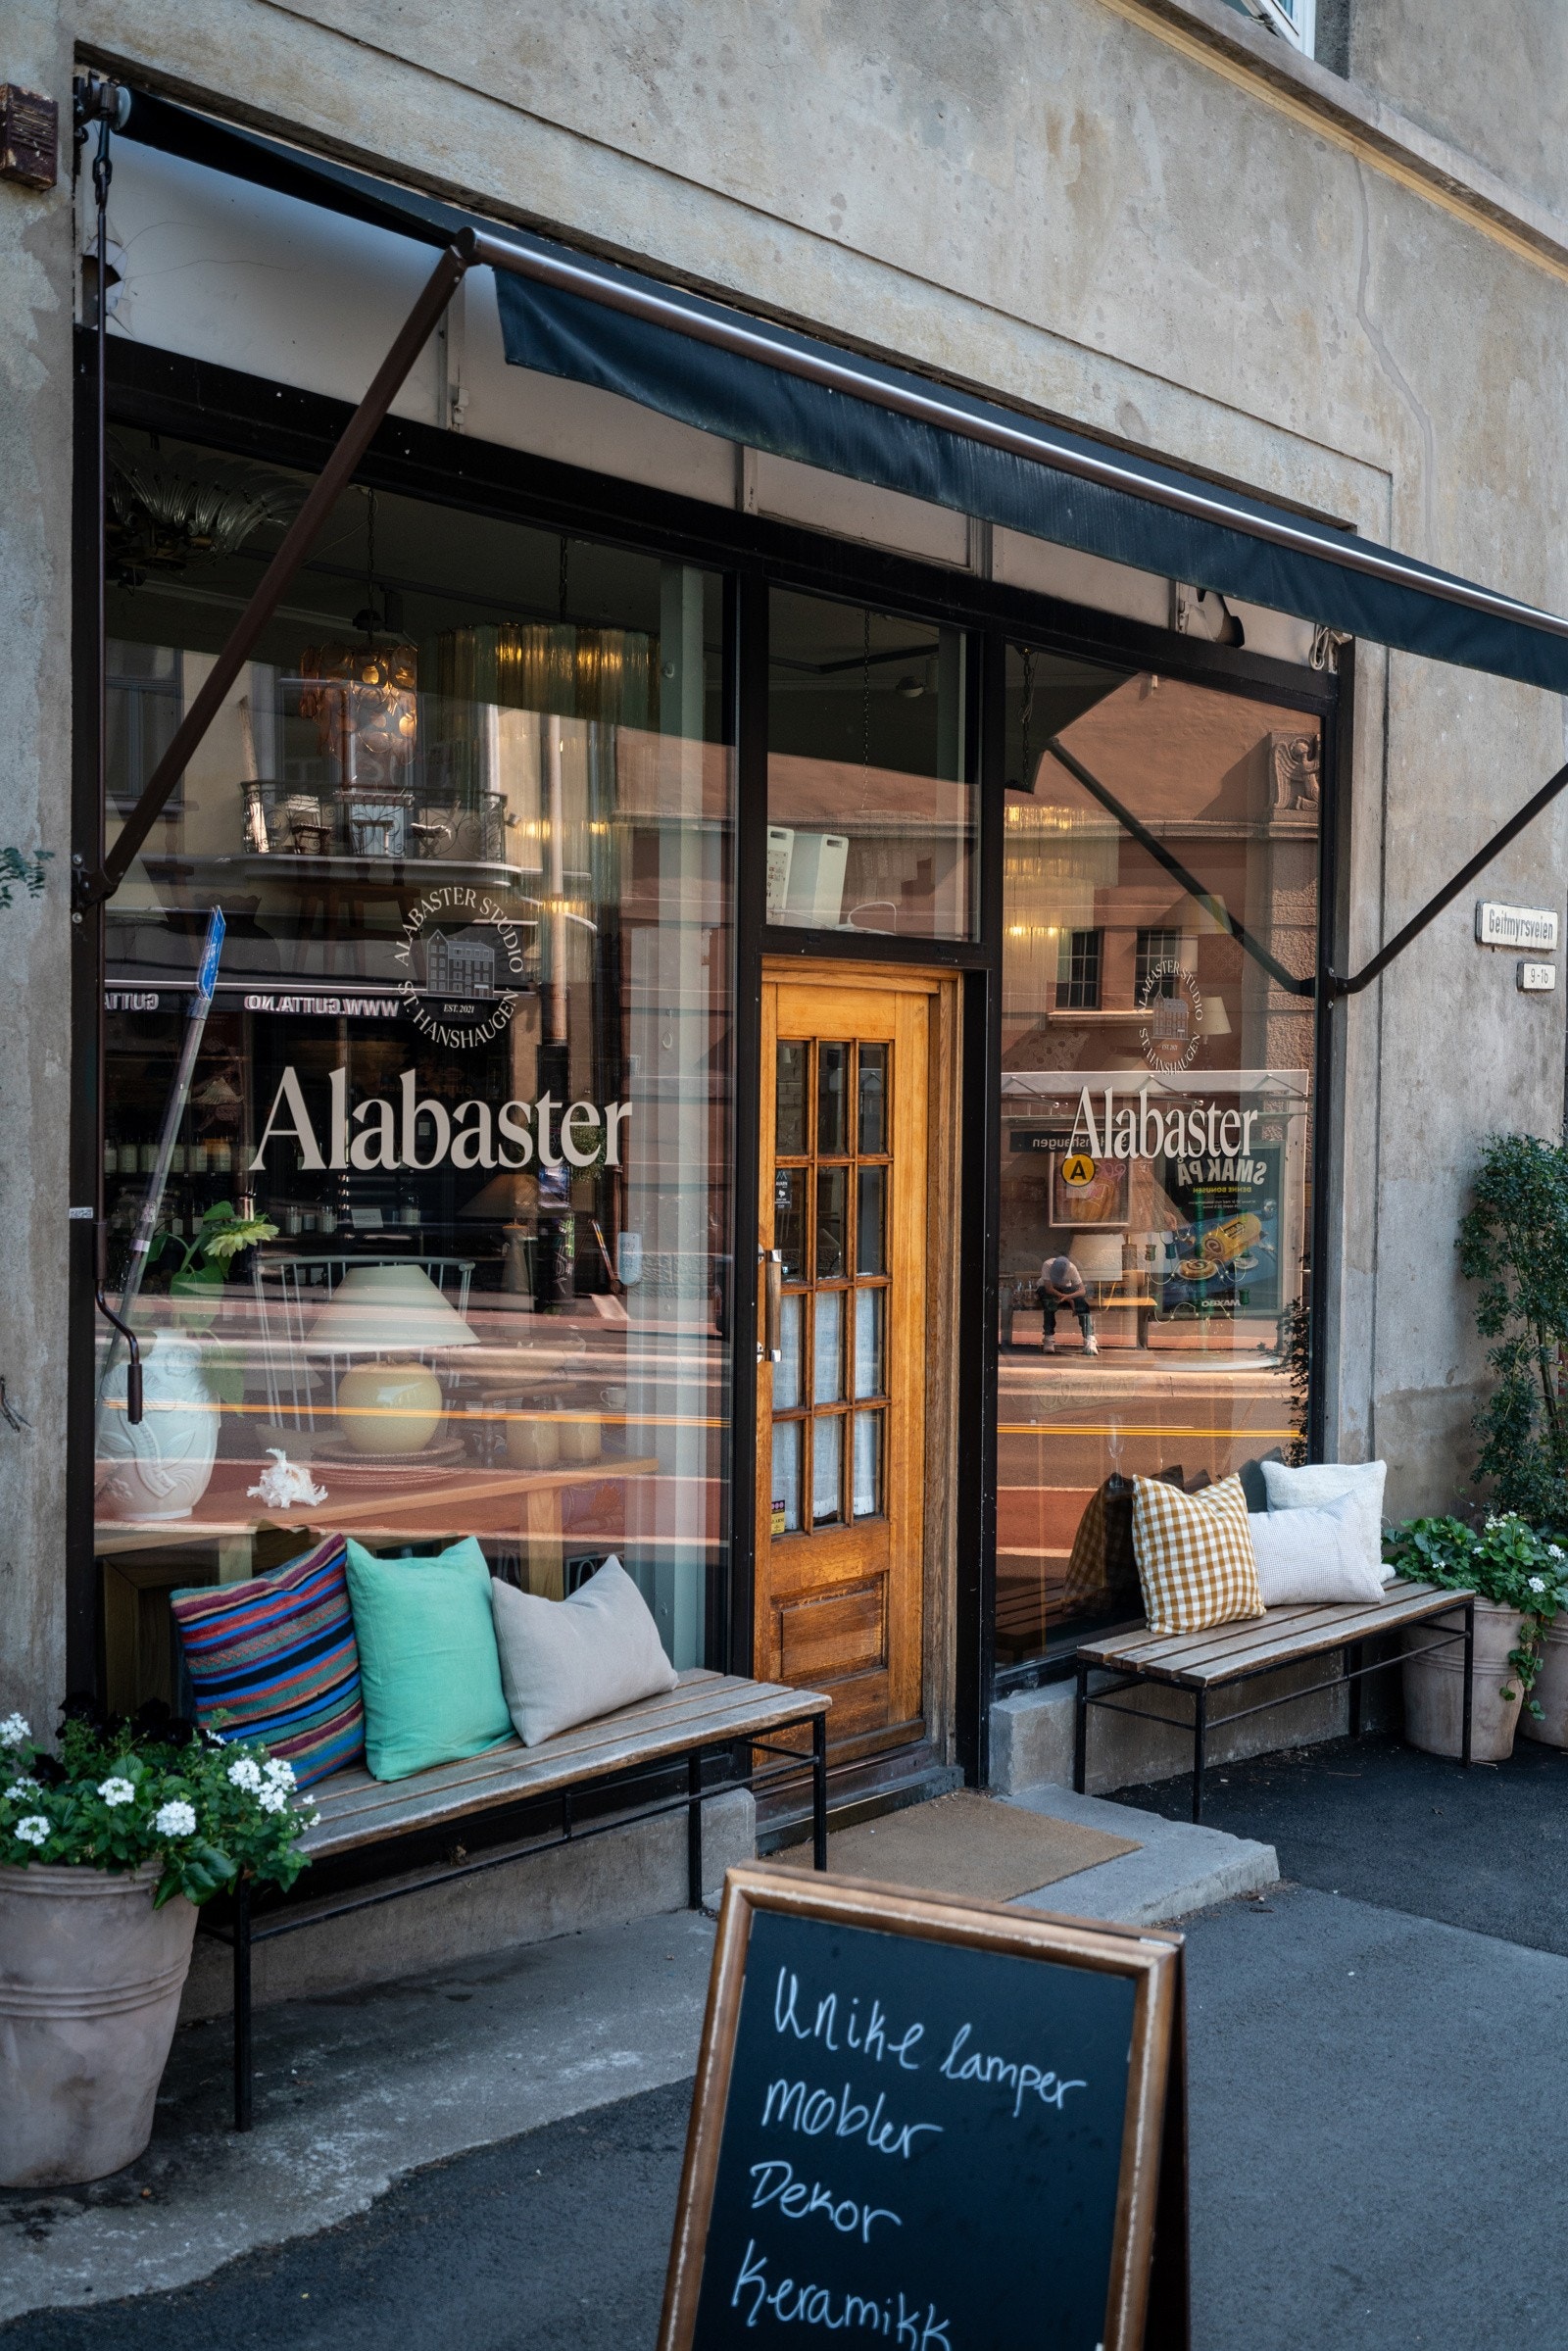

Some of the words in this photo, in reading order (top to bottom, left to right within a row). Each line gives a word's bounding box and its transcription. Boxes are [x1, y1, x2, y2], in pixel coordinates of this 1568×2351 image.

[394, 887, 477, 966] ALABASTER
[479, 898, 524, 974] STUDIO
[1489, 908, 1553, 942] Geitmyrsveien
[398, 980, 419, 1013] ST.
[413, 988, 519, 1049] HANSHAUGEN
[443, 1004, 458, 1013] EST.
[459, 1004, 475, 1014] 2021
[1138, 959, 1180, 1018] ALABASTER
[1180, 967, 1203, 1021] STUDIO
[1146, 1031, 1201, 1076] HANSHAUGEN
[248, 1066, 633, 1171] Alabaster
[1065, 1085, 1258, 1160] Alabaster
[774, 1966, 924, 2069] Unike
[940, 2023, 1087, 2117] lamper
[750, 2160, 903, 2243] Dekor
[731, 2238, 953, 2351] Keramikk
